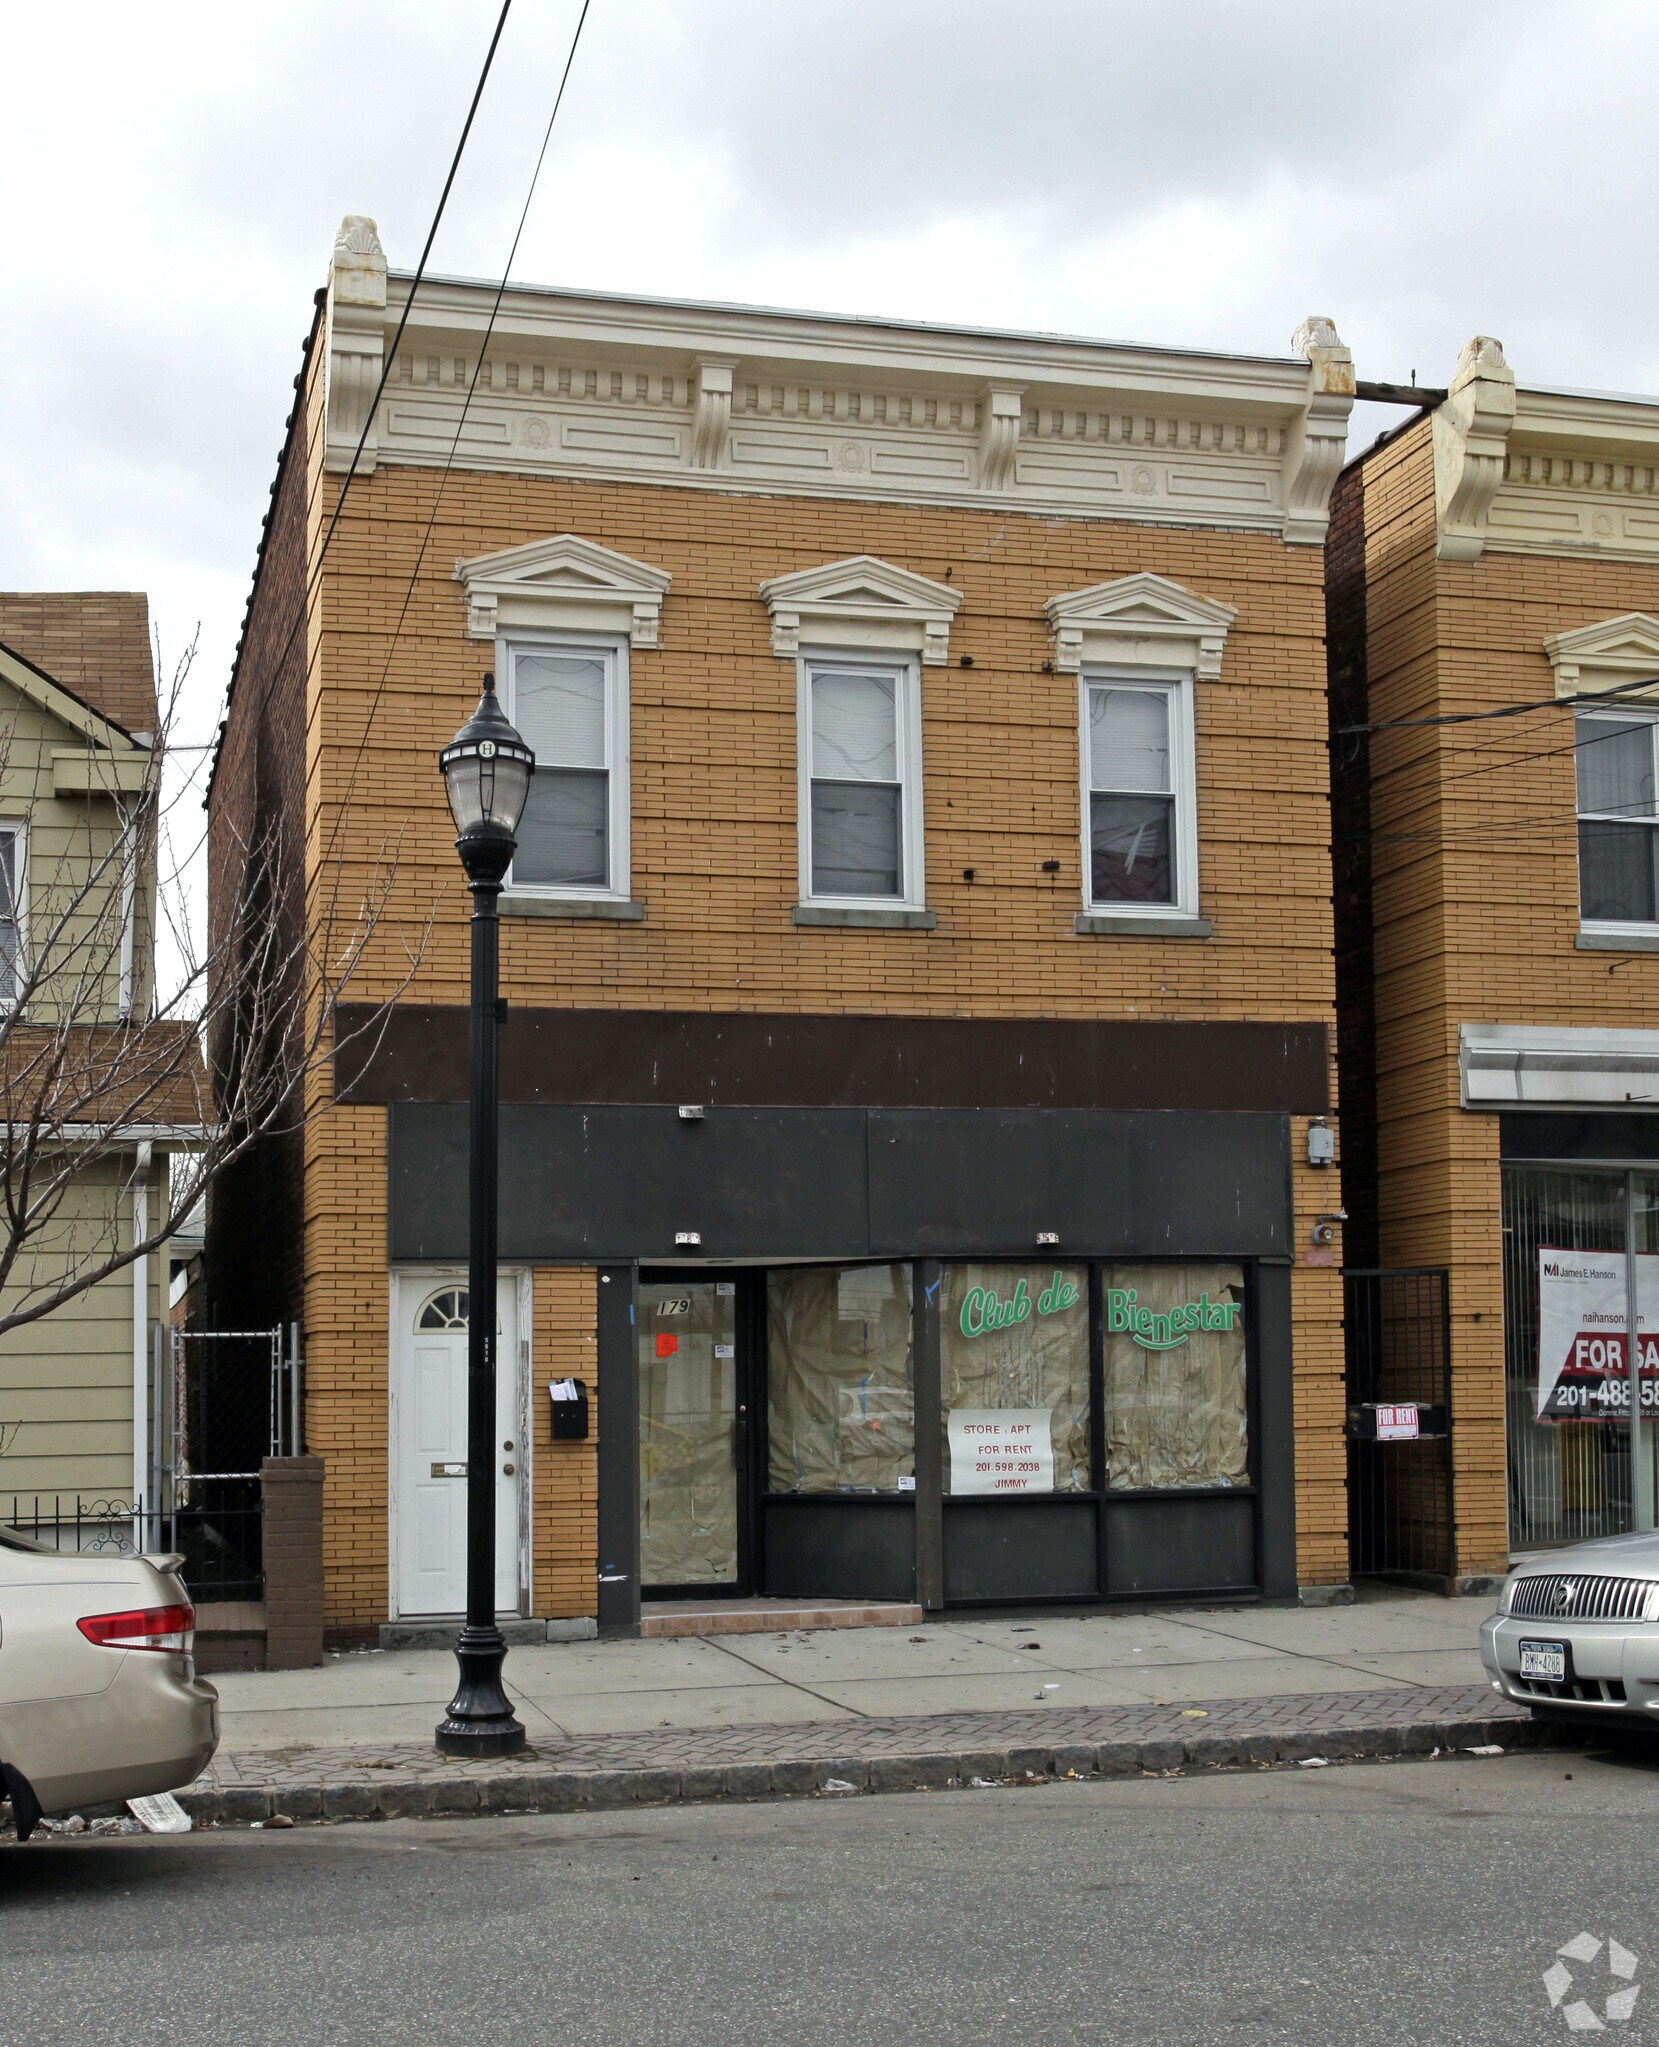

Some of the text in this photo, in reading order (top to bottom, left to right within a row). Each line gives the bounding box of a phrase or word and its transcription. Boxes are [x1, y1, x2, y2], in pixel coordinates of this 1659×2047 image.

[482, 743, 493, 755] H
[1544, 1263, 1559, 1277] NAI
[1560, 1268, 1583, 1278] James
[1590, 1270, 1616, 1280] Hanson
[661, 1300, 689, 1315] 179
[960, 1270, 1242, 1342] Club de Bienestar
[1583, 1312, 1645, 1324] naihanson.m
[1576, 1339, 1623, 1369] FOR
[1556, 1380, 1659, 1406] 201-48858
[1378, 1407, 1416, 1425] FOR RENT
[964, 1425, 1031, 1434] STORE APT
[978, 1445, 1032, 1454] FOR RENT
[995, 1479, 1028, 1489] JIMMY
